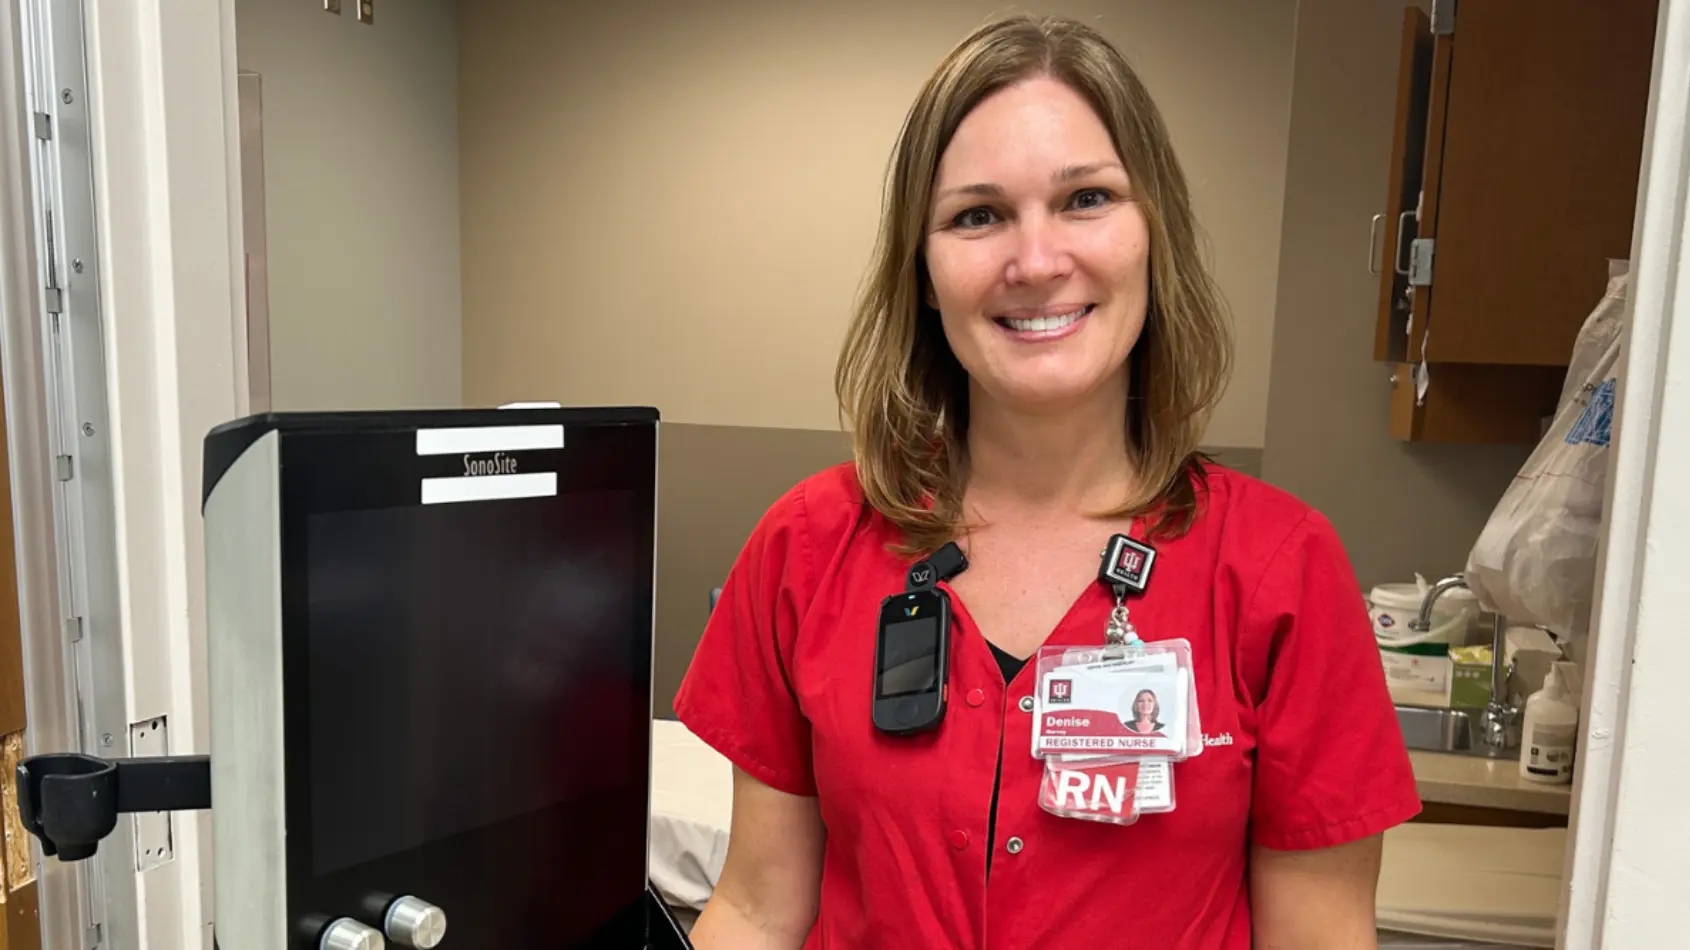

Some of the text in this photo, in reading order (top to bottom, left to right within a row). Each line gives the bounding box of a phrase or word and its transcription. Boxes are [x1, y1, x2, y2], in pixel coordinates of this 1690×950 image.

[463, 452, 518, 476] SonoSite
[1046, 716, 1090, 728] Denise
[1046, 738, 1157, 748] REGISTERED NURSE
[1055, 769, 1127, 814] RN
